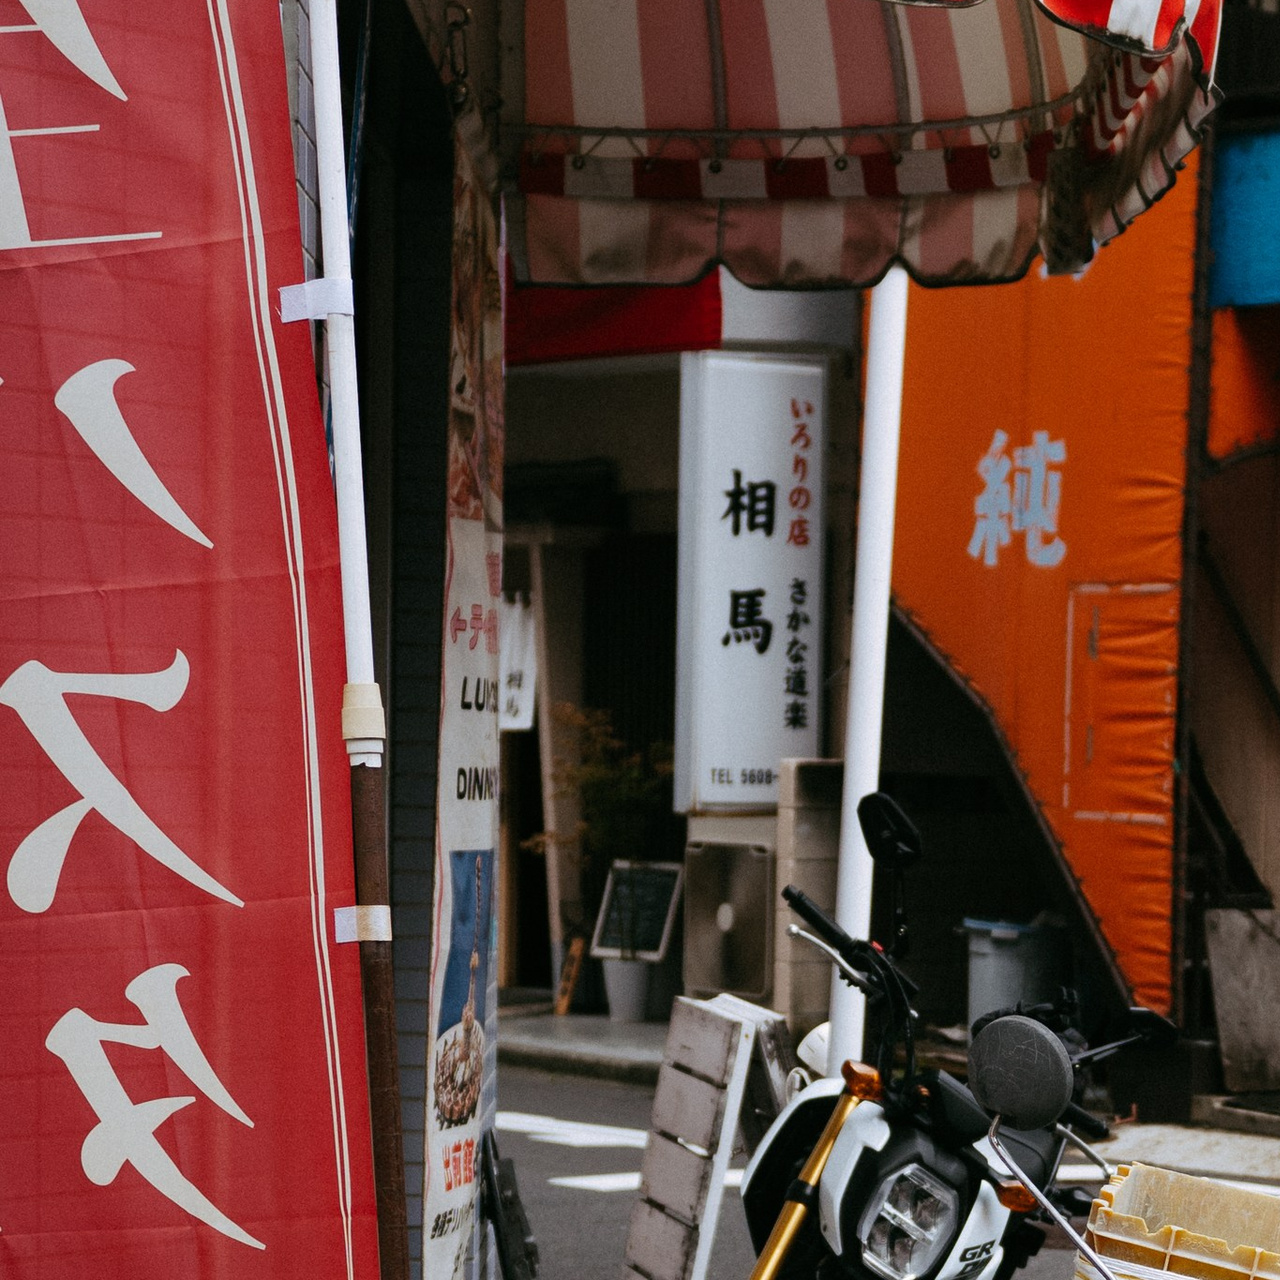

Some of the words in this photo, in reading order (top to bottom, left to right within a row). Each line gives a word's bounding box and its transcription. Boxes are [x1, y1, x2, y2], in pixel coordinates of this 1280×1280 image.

[786, 397, 814, 547] いろりの店
[967, 429, 1067, 568] 純
[721, 469, 777, 655] 相馬
[711, 768, 733, 785] TEL
